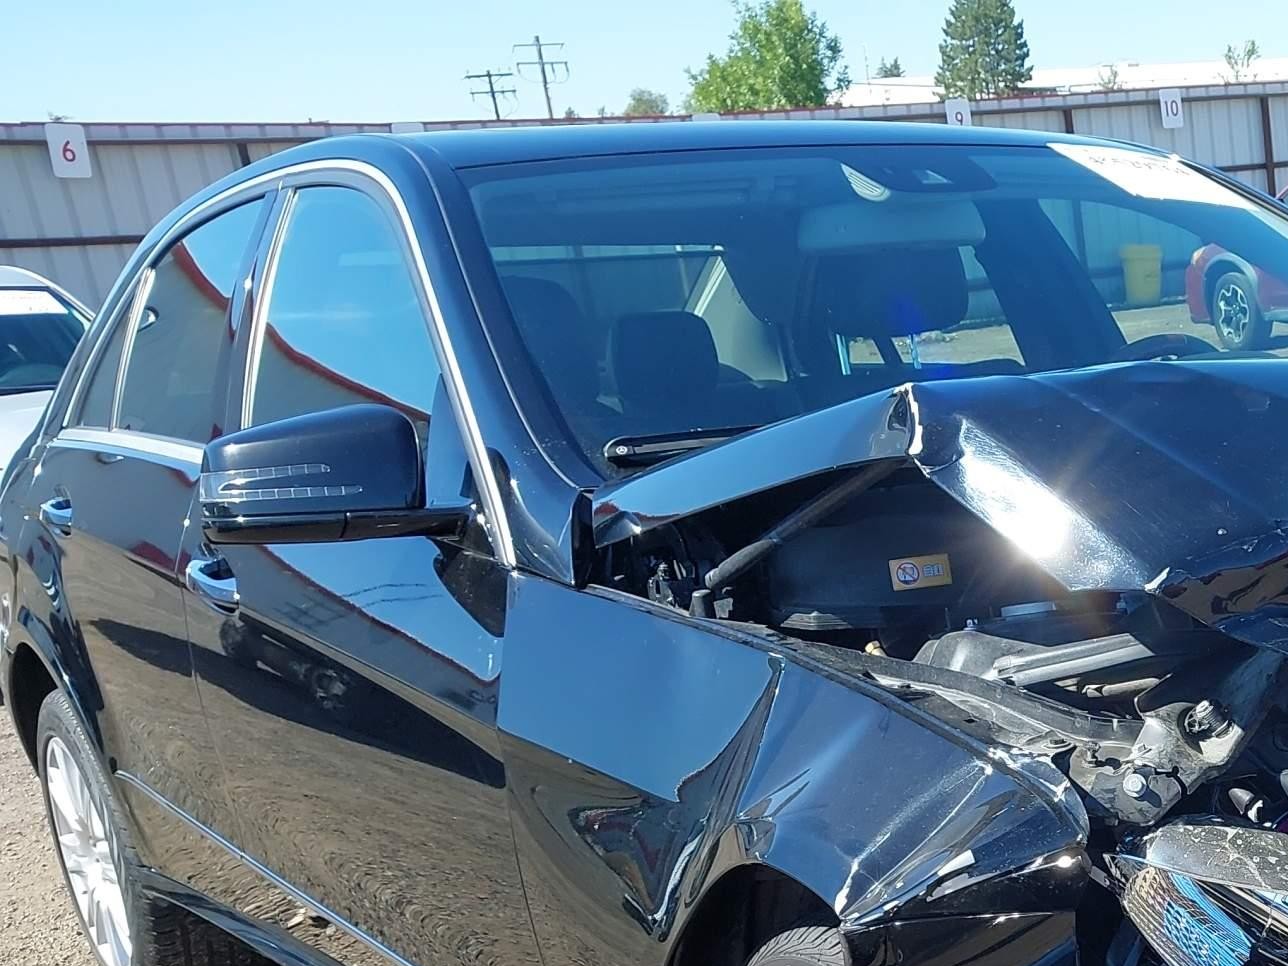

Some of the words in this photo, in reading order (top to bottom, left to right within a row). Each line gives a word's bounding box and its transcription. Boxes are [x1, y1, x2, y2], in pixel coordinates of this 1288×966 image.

[1164, 99, 1179, 117] 10
[954, 111, 964, 126] 9
[62, 139, 76, 162] 6
